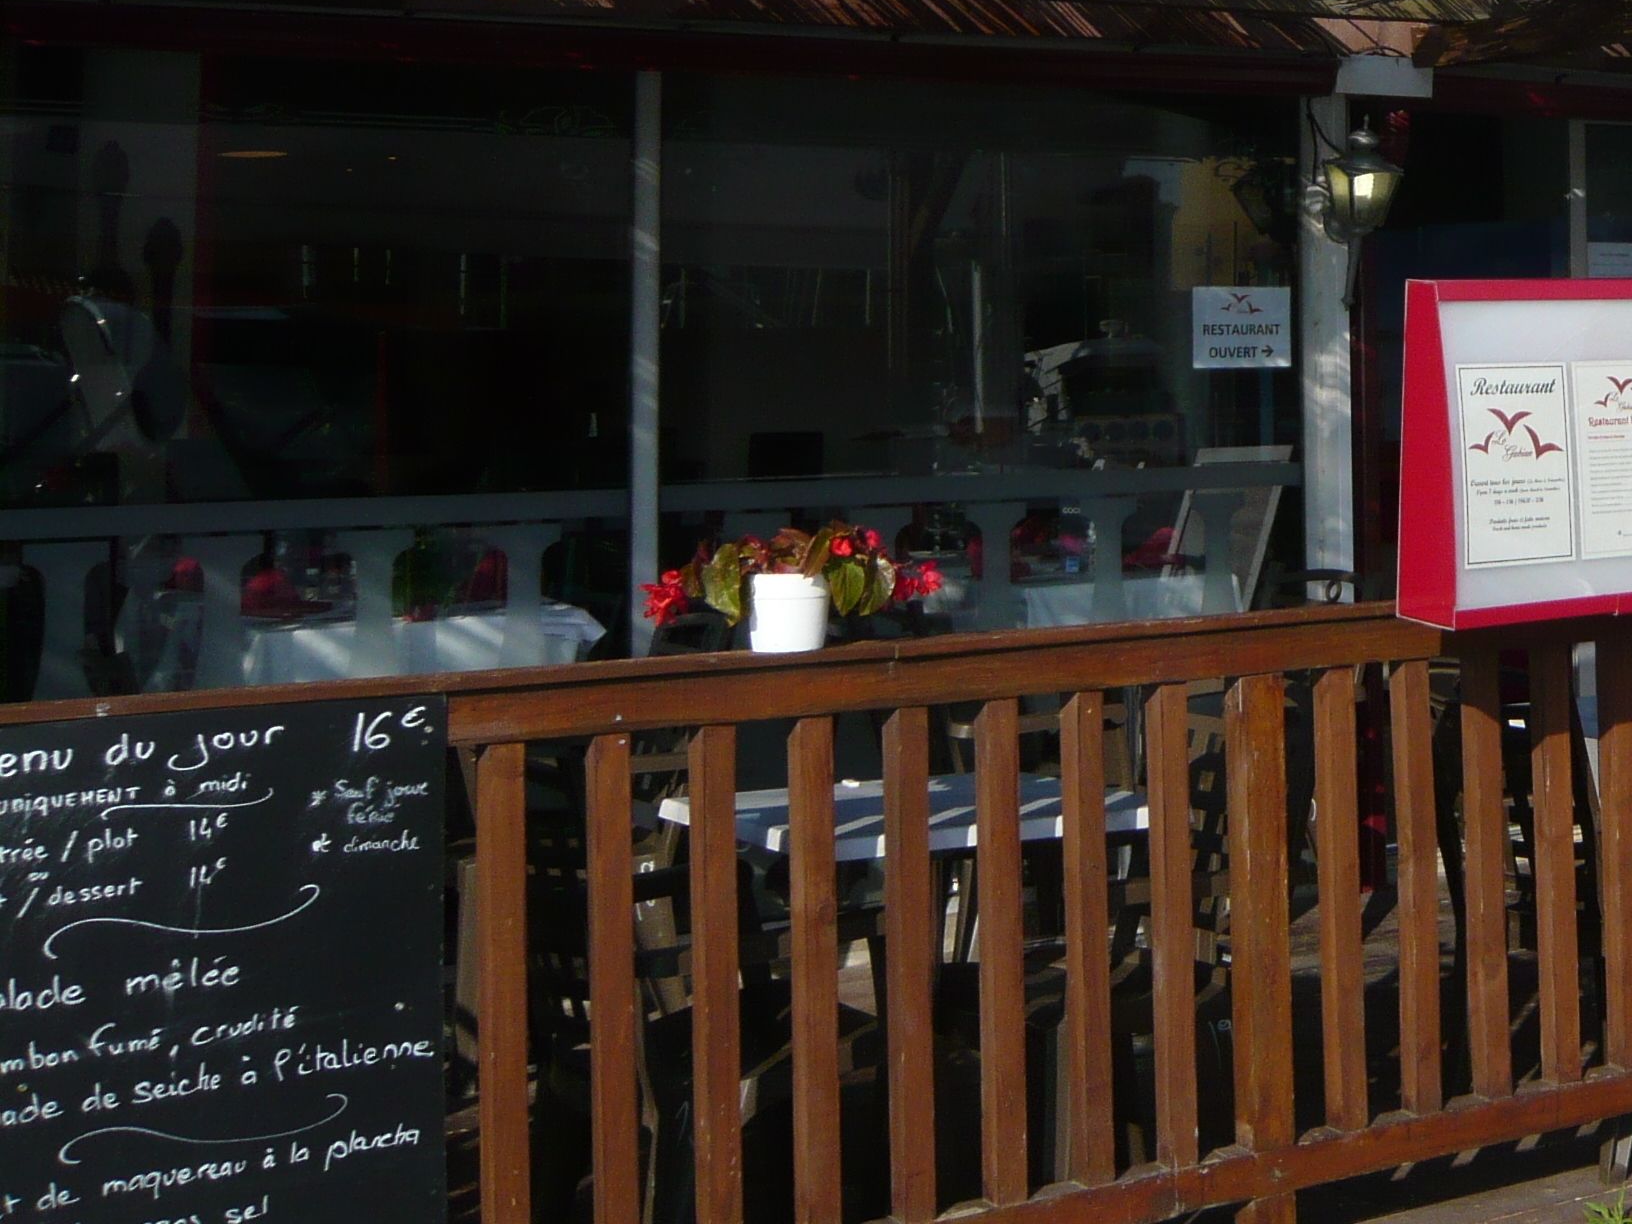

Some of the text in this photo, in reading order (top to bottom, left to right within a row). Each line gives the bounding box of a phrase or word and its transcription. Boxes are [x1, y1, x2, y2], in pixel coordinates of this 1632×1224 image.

[1202, 323, 1280, 336] RESTAURANT
[1208, 345, 1258, 359] OUVERT
[1470, 377, 1556, 396] Restaurant
[0, 748, 73, 777] enu
[105, 733, 156, 765] du
[167, 725, 285, 771] jour
[198, 771, 252, 792] midi
[0, 838, 49, 864] trée
[343, 829, 420, 853] dimanche
[47, 877, 143, 906] dessert
[126, 956, 241, 995] mêlée
[0, 1040, 79, 1074] mbon
[82, 1082, 120, 1112] de
[241, 1055, 257, 1085] à
[36, 1182, 81, 1210] de
[102, 1160, 247, 1200] maquereau
[262, 1148, 277, 1168] à
[290, 1141, 310, 1164] la
[224, 1195, 270, 1224] sel
